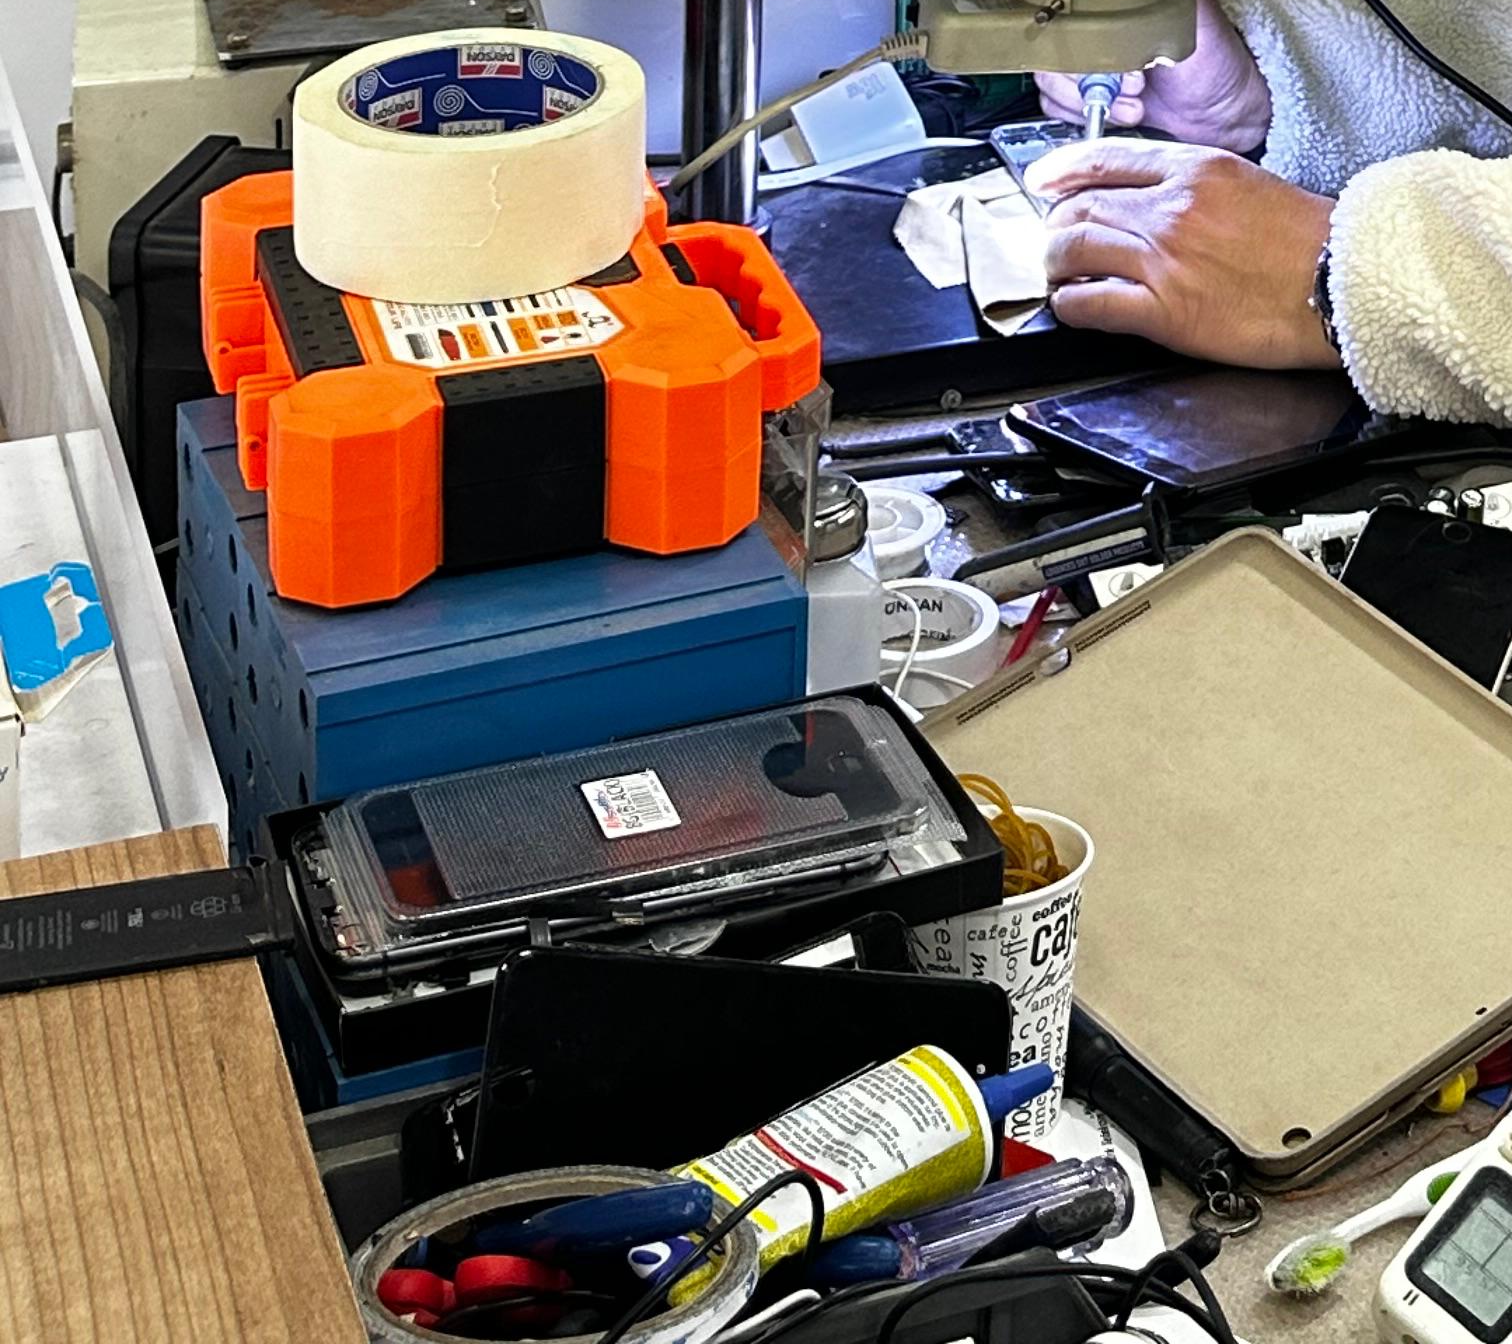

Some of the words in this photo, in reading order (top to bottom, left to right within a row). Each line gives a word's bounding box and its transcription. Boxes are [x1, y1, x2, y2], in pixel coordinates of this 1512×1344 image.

[467, 50, 516, 63] DAYSON
[372, 99, 416, 121] DAYSON
[884, 599, 943, 615] ONAN
[966, 925, 1007, 941] cafe
[1000, 913, 1028, 982] coffee
